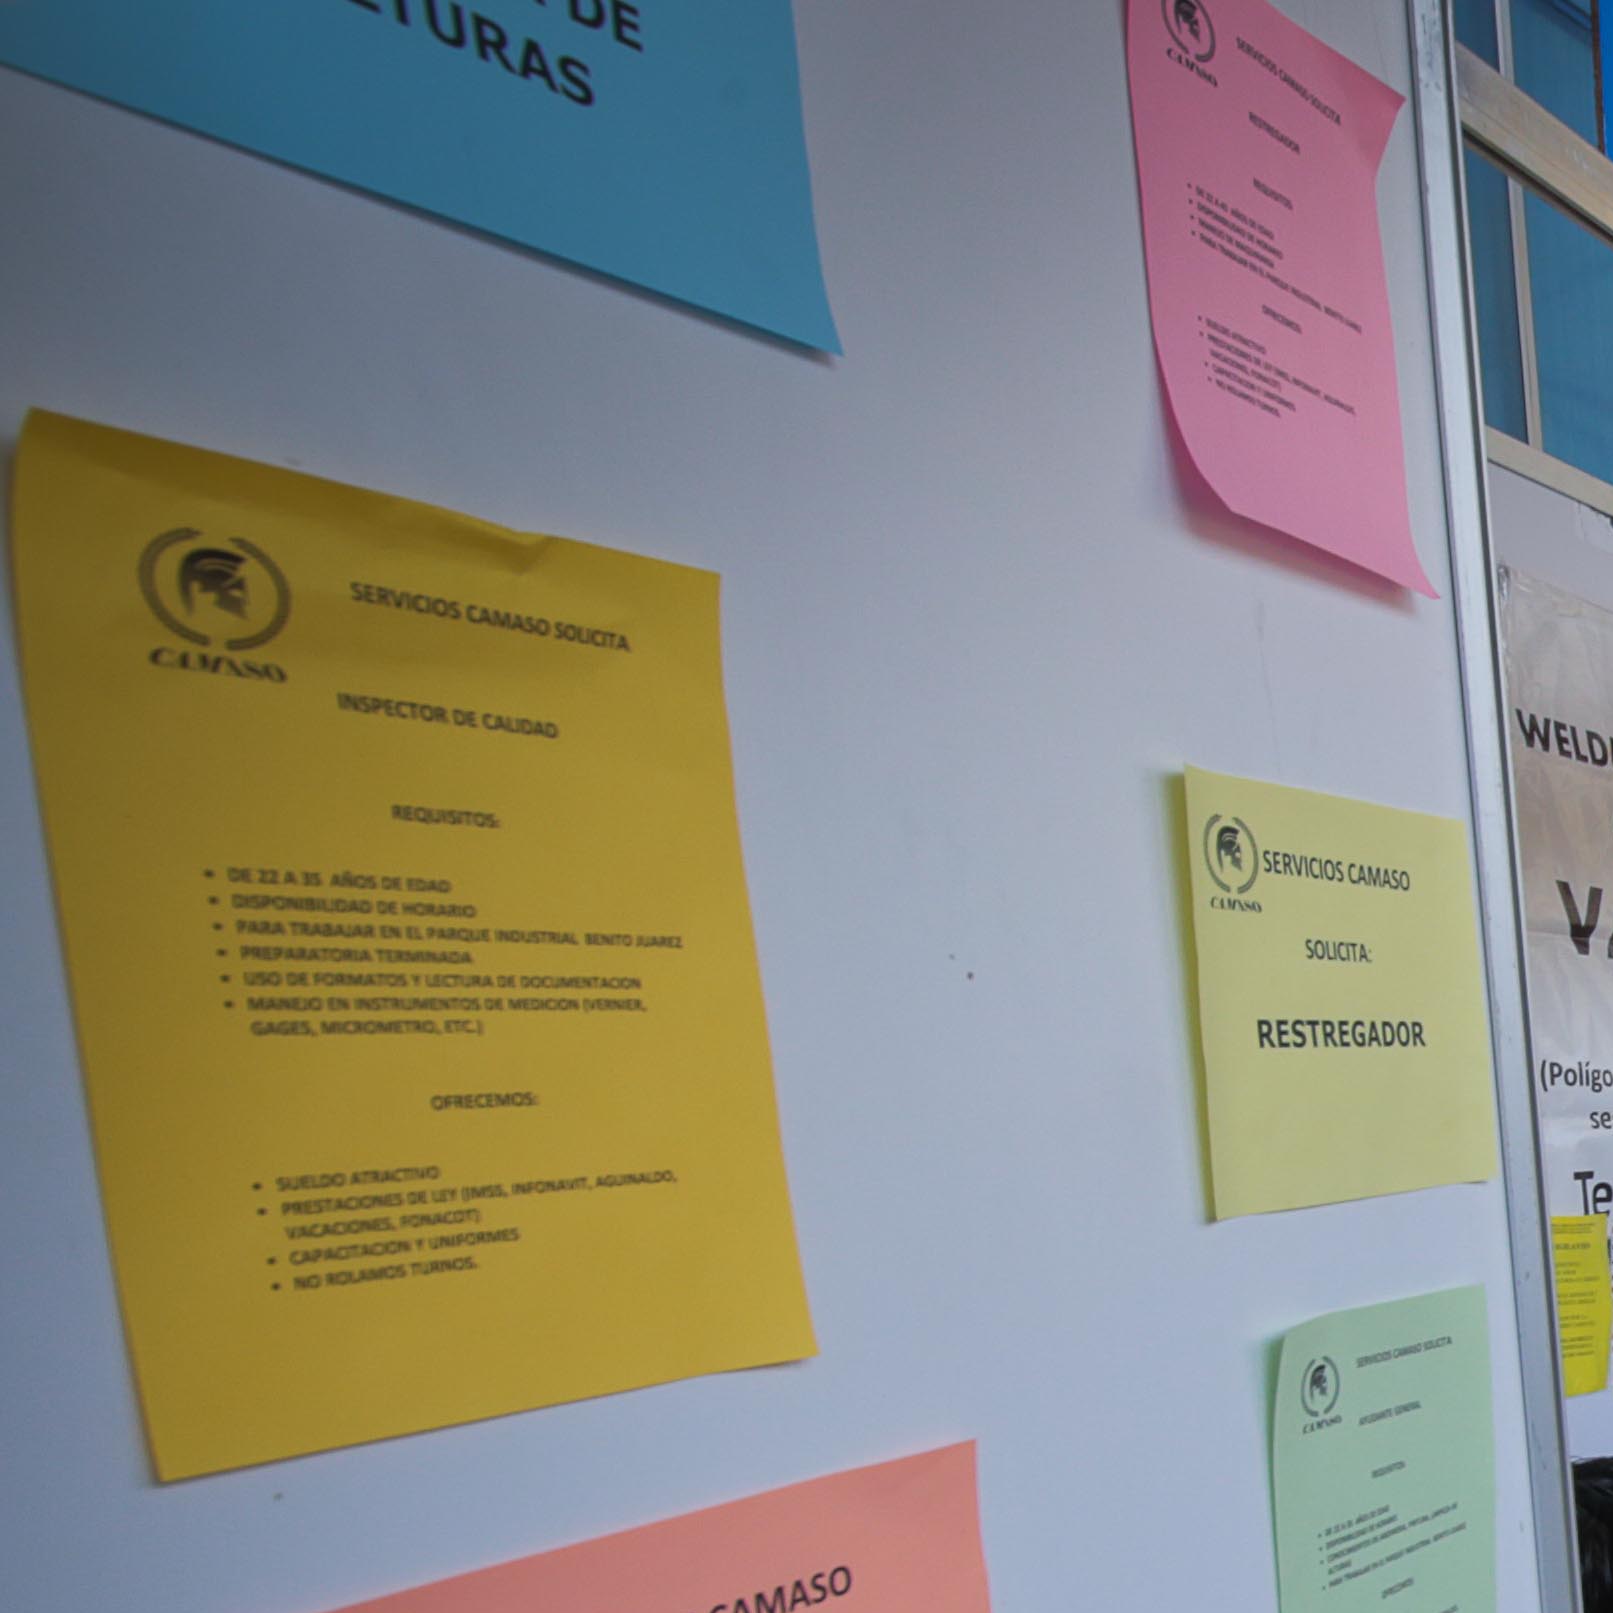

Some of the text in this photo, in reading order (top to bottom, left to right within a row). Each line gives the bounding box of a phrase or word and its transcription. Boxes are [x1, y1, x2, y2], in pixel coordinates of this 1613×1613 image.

[345, 0, 596, 106] URAS
[351, 581, 630, 653] SERVICIOS CAMASO SOLICITA
[148, 645, 288, 684] CAMASO
[337, 692, 559, 739] INSPECTOR DE CALIDAD
[390, 804, 500, 829] REQUISITOS:
[227, 867, 250, 883] DE
[284, 871, 297, 885] A
[330, 871, 376, 890] AÑOS
[381, 876, 401, 891] DE
[406, 878, 452, 893] EDAD
[1263, 849, 1410, 891] SERVICIOS CAMASO
[232, 894, 477, 918] DISPONIBILIDAD DE HORARIO
[1210, 895, 1262, 914] CAMASO
[236, 919, 285, 935] PARA
[289, 921, 375, 938] TRABAJAR
[380, 925, 402, 939] EN
[406, 927, 423, 940] EL
[426, 927, 490, 943] PARQUE
[495, 929, 579, 946] INDUSTRIAL
[584, 933, 632, 947] BENITO
[240, 946, 472, 964] PREPARATORIA TERMINADA
[1305, 938, 1372, 963] SOLICITA:
[244, 972, 282, 986] USO
[286, 972, 307, 986] DE
[313, 973, 407, 987] FORMATOS
[412, 974, 421, 986] Y
[426, 974, 493, 988] LECTURA
[497, 974, 516, 988] DE
[247, 997, 322, 1011] MANEJO
[327, 998, 348, 1011] EN
[355, 998, 481, 1011] INSTRUMENTOS
[484, 998, 503, 1011] DE
[1257, 1019, 1426, 1048] RESTREGADOR
[430, 1092, 539, 1111] OFRECEMOS:
[276, 1166, 440, 1192] SUELDO ATRACTIVO
[281, 1193, 402, 1216] PRESTACIONES
[406, 1191, 428, 1205] DE
[431, 1188, 457, 1203] LEY
[416, 1238, 425, 1252] Y
[429, 1228, 520, 1250] UNIFORMES
[293, 1274, 320, 1291] NO
[325, 1265, 406, 1287] ROLAMOS
